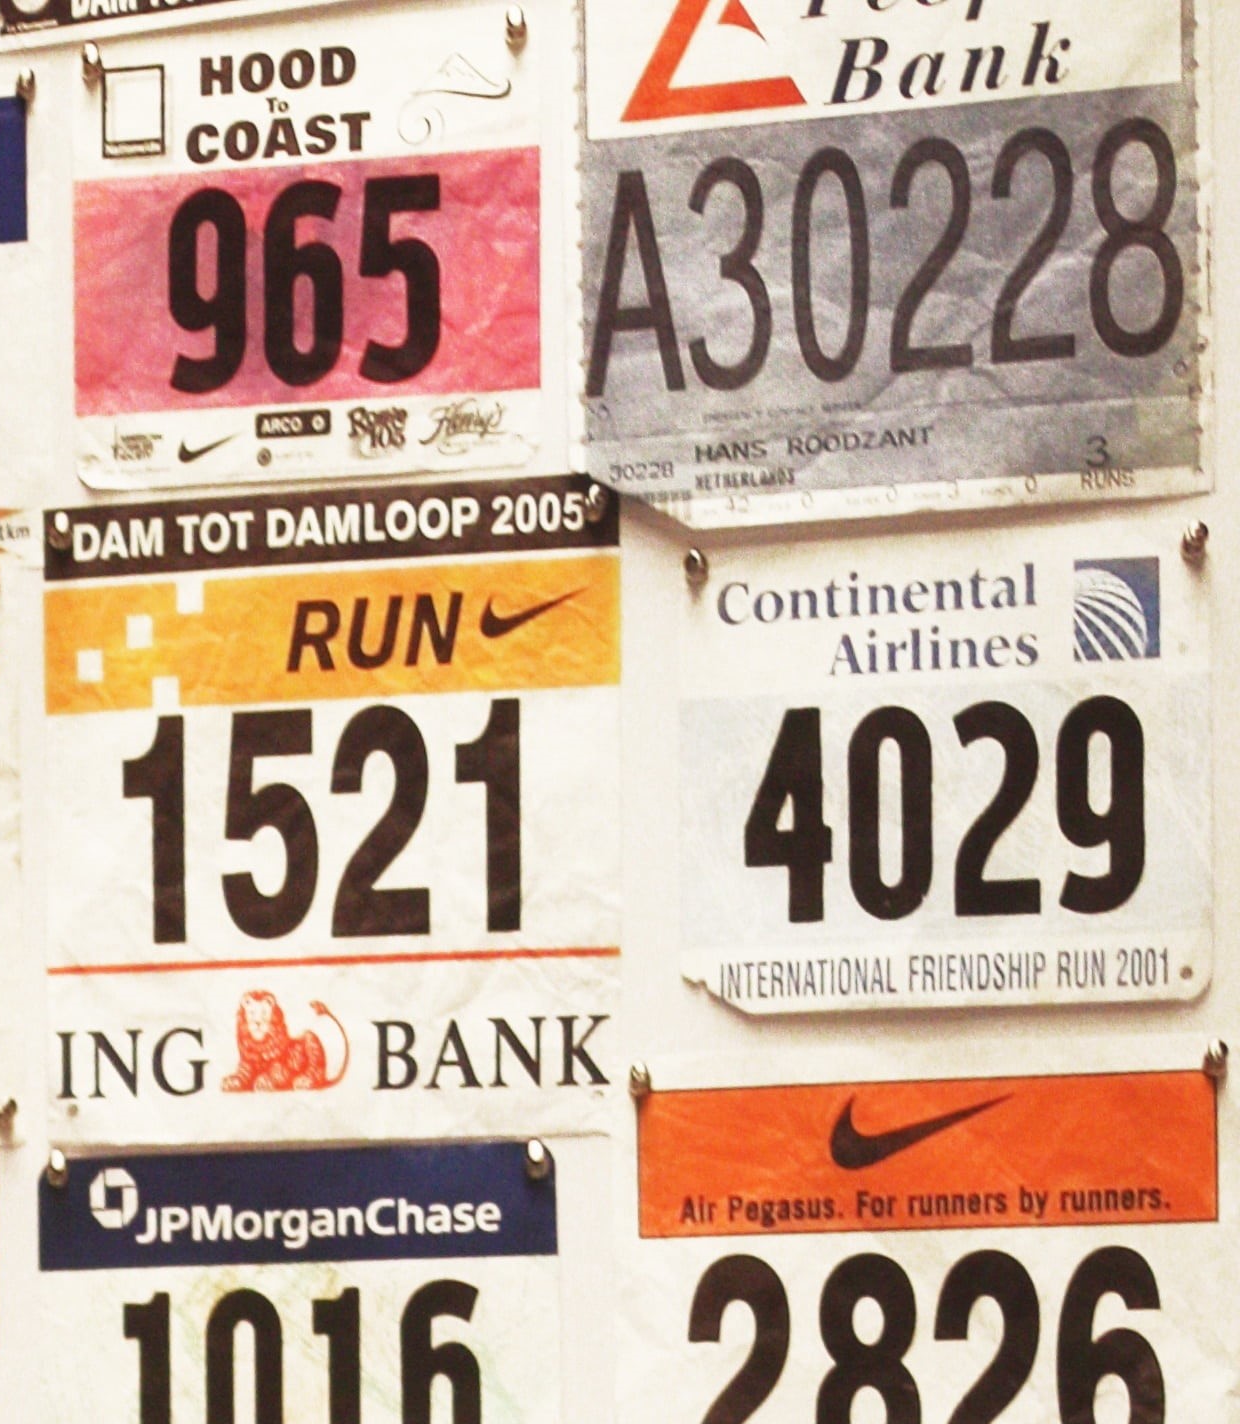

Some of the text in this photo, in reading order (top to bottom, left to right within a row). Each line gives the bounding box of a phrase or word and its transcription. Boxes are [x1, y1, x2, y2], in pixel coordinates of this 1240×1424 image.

[200, 46, 356, 97] HOOD
[824, 21, 1072, 105] Bank
[186, 112, 371, 163] COAST
[168, 174, 441, 394] 965
[585, 116, 1184, 397] A30228
[261, 414, 303, 435] ARCO
[694, 425, 934, 464] HANS ROODZANT
[1085, 435, 1110, 468] 3
[72, 494, 585, 563] DAM TOT DAMLOOP 2005
[717, 563, 1038, 626] Continental
[287, 592, 463, 673] RUN
[829, 625, 1039, 677] Airlines
[123, 697, 521, 944] 1521
[744, 695, 1146, 923] 4029
[719, 948, 1169, 1000] INTERNATIONAL FRIENDSHIP RUN 2001
[57, 1014, 611, 1100] ING BANK
[136, 1197, 502, 1249] JPMorganChase
[680, 1184, 1171, 1228] Air Pegasus. For runners by runners.
